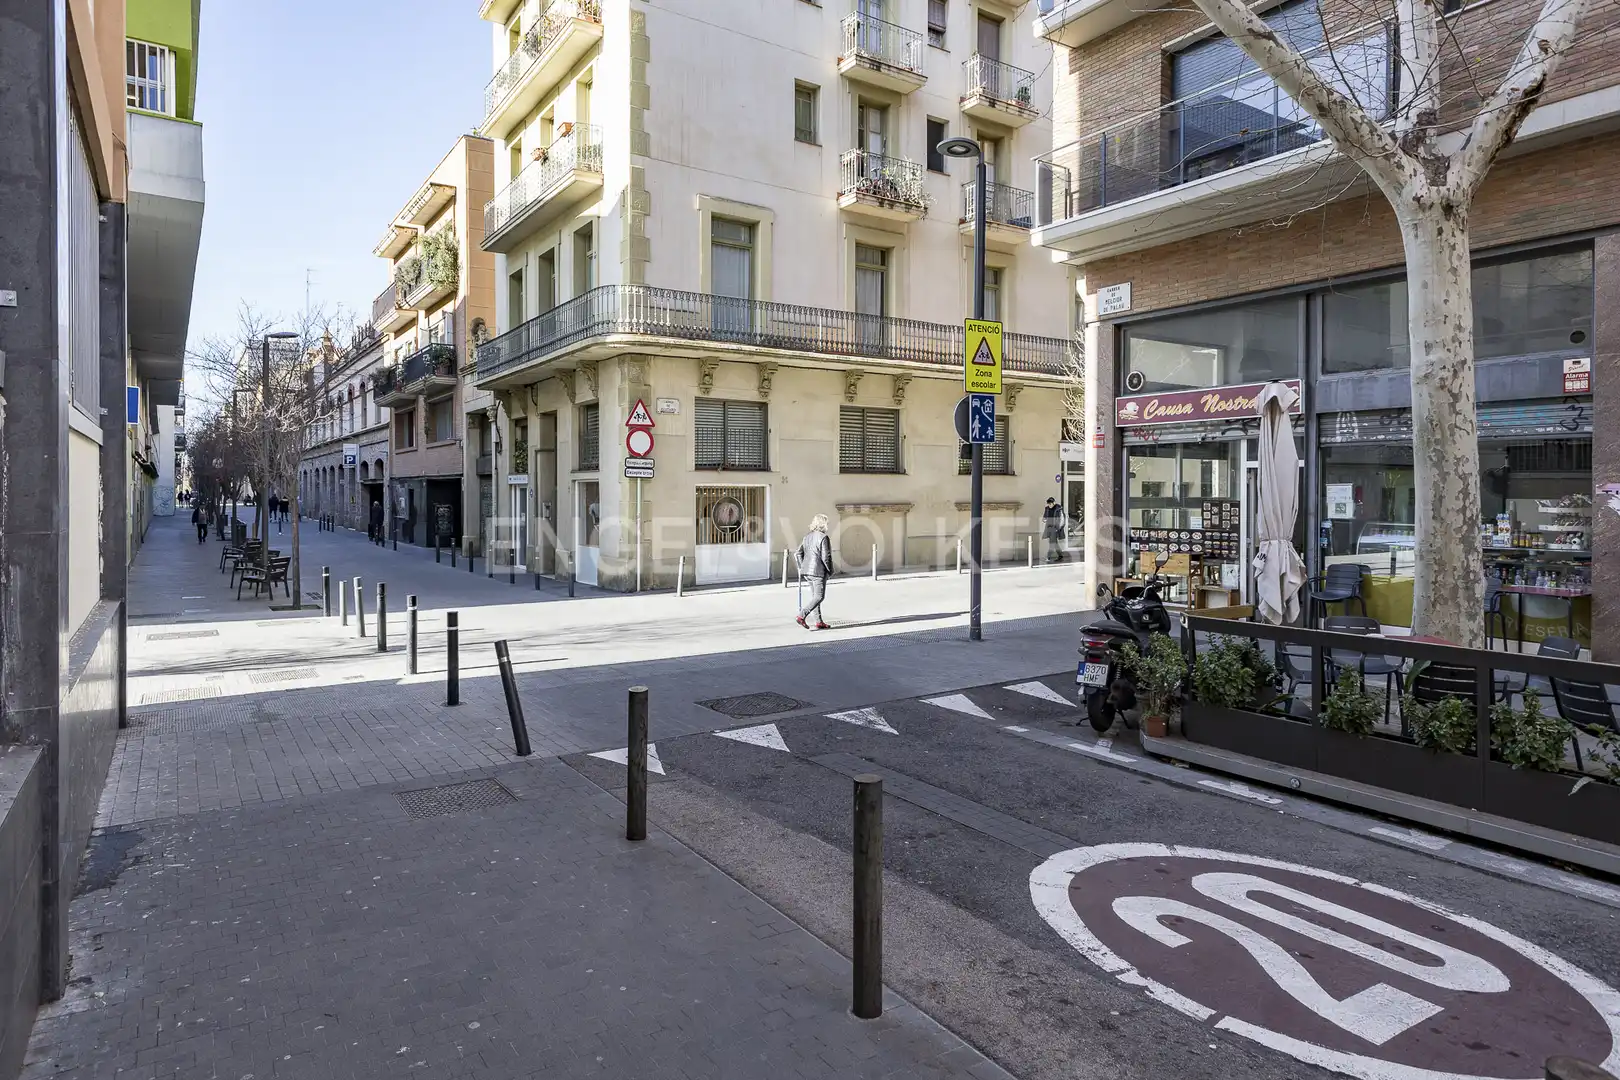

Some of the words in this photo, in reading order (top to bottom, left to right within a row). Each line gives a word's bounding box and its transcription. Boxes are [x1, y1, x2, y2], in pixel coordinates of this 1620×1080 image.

[967, 324, 1000, 335] ATENCIÓ
[975, 369, 993, 378] Zona
[971, 380, 996, 389] escolar
[1143, 398, 1194, 420] Causa
[1112, 872, 1511, 1046] 20
